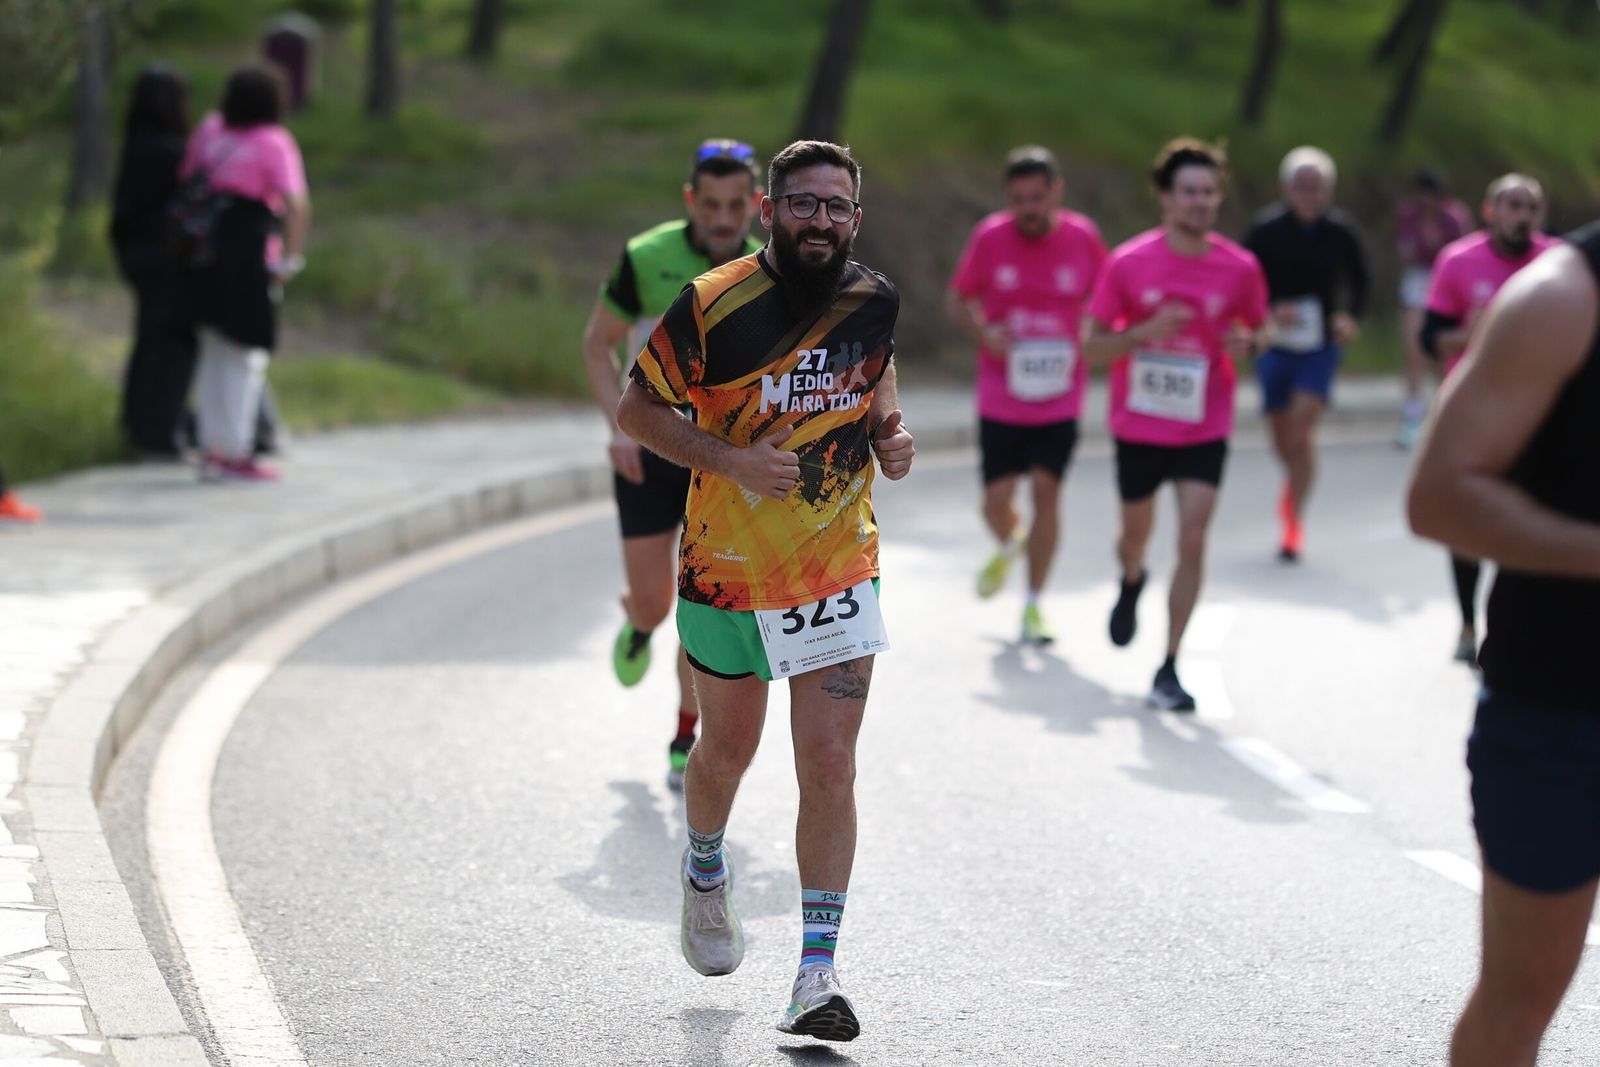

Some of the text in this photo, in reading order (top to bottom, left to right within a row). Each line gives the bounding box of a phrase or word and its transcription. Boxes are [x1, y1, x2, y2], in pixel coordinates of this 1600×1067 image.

[797, 349, 828, 372] 27
[1140, 368, 1195, 400] 630
[782, 587, 860, 635] 323
